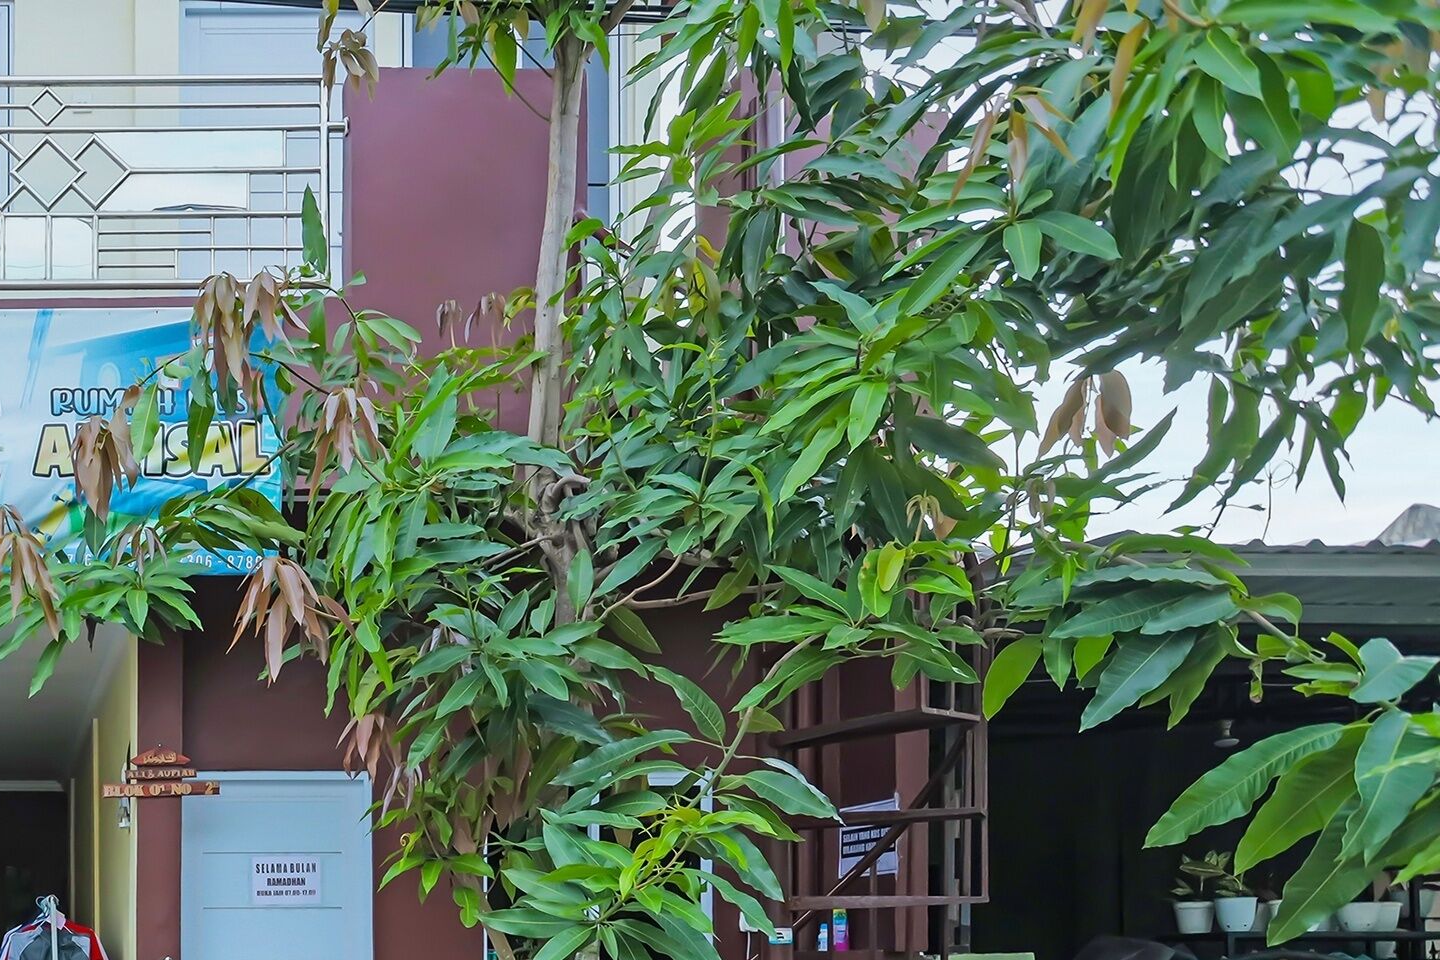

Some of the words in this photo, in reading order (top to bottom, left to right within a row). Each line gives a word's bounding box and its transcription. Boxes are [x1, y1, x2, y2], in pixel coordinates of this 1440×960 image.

[103, 784, 144, 797] BLOK
[171, 783, 192, 795] NO
[289, 862, 317, 873] BULAN
[266, 877, 306, 887] RAMADHAN
